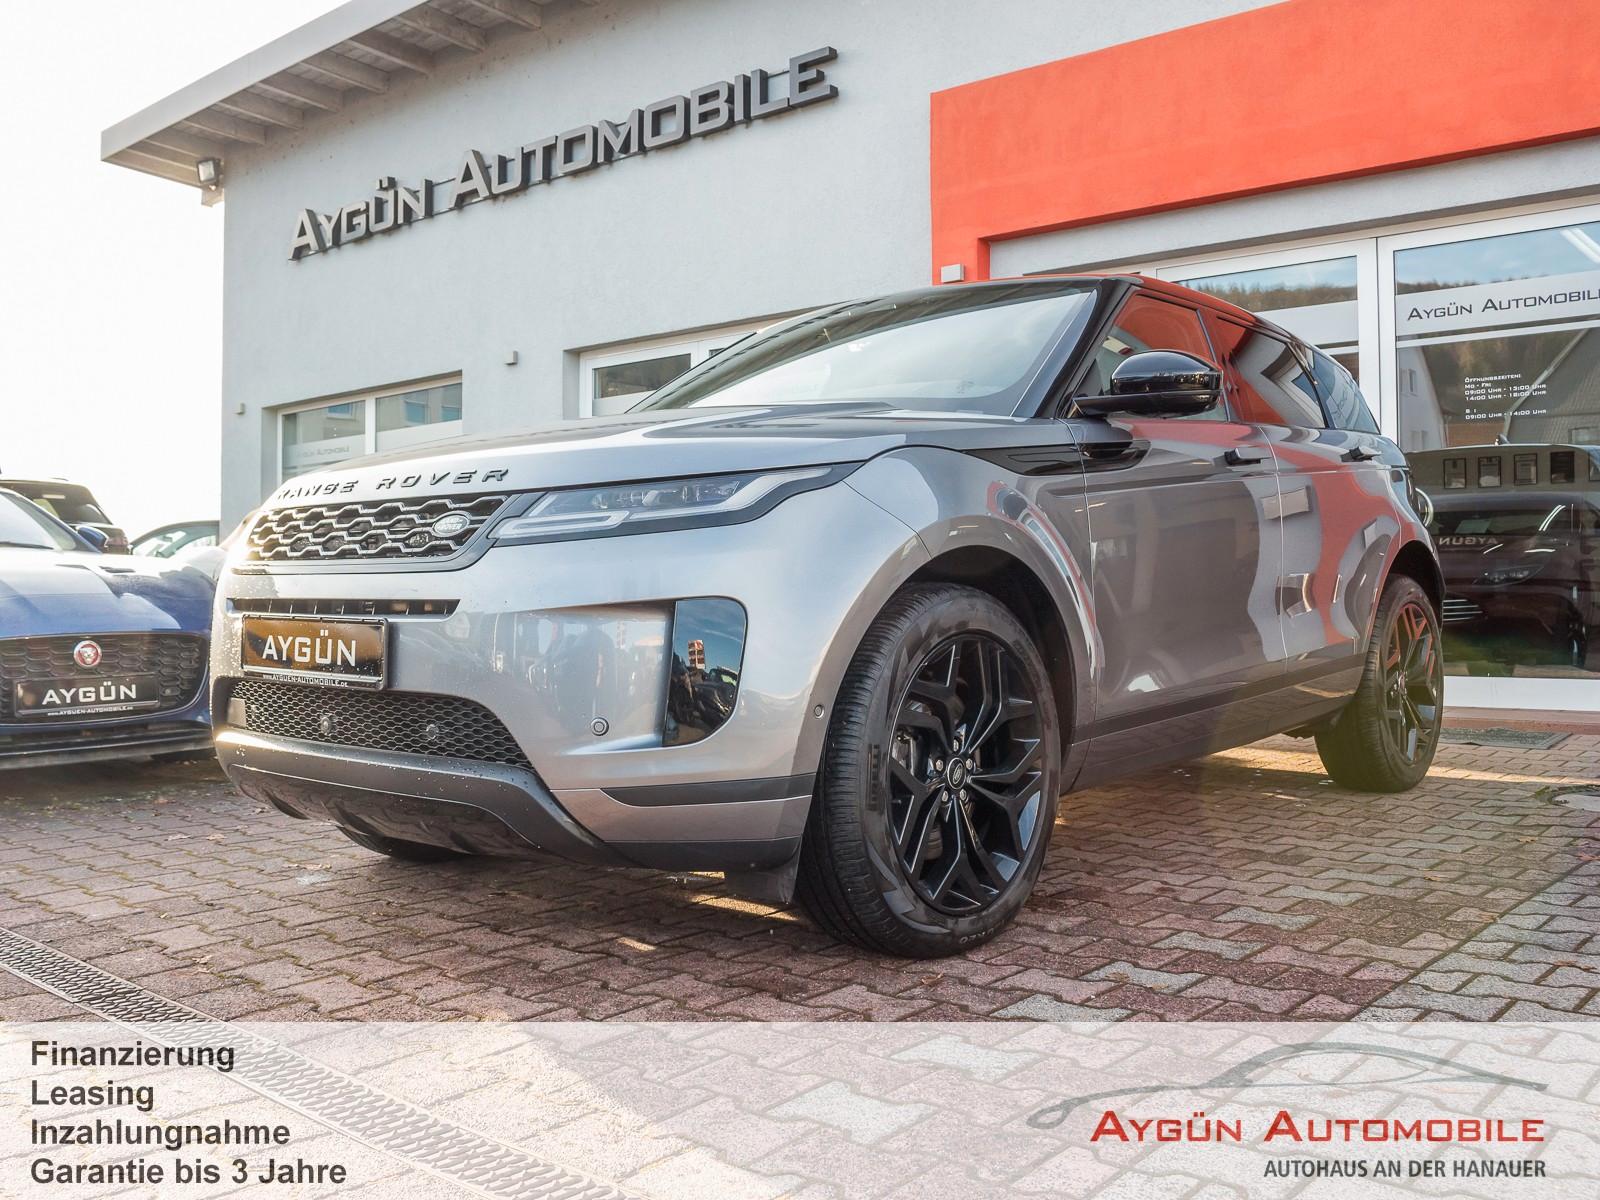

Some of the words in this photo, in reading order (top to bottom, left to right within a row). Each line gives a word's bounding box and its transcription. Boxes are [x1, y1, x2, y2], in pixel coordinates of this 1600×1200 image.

[289, 177, 433, 261] AYGÜN
[450, 46, 838, 208] AUTOMOBILE
[1407, 301, 1473, 321] AYGÜN
[1481, 289, 1600, 313] AUTOMOBIL
[277, 480, 359, 500] RANGE
[376, 469, 509, 490] ROVER
[262, 629, 356, 667] AYGÜN
[41, 681, 137, 705] AYGÜN
